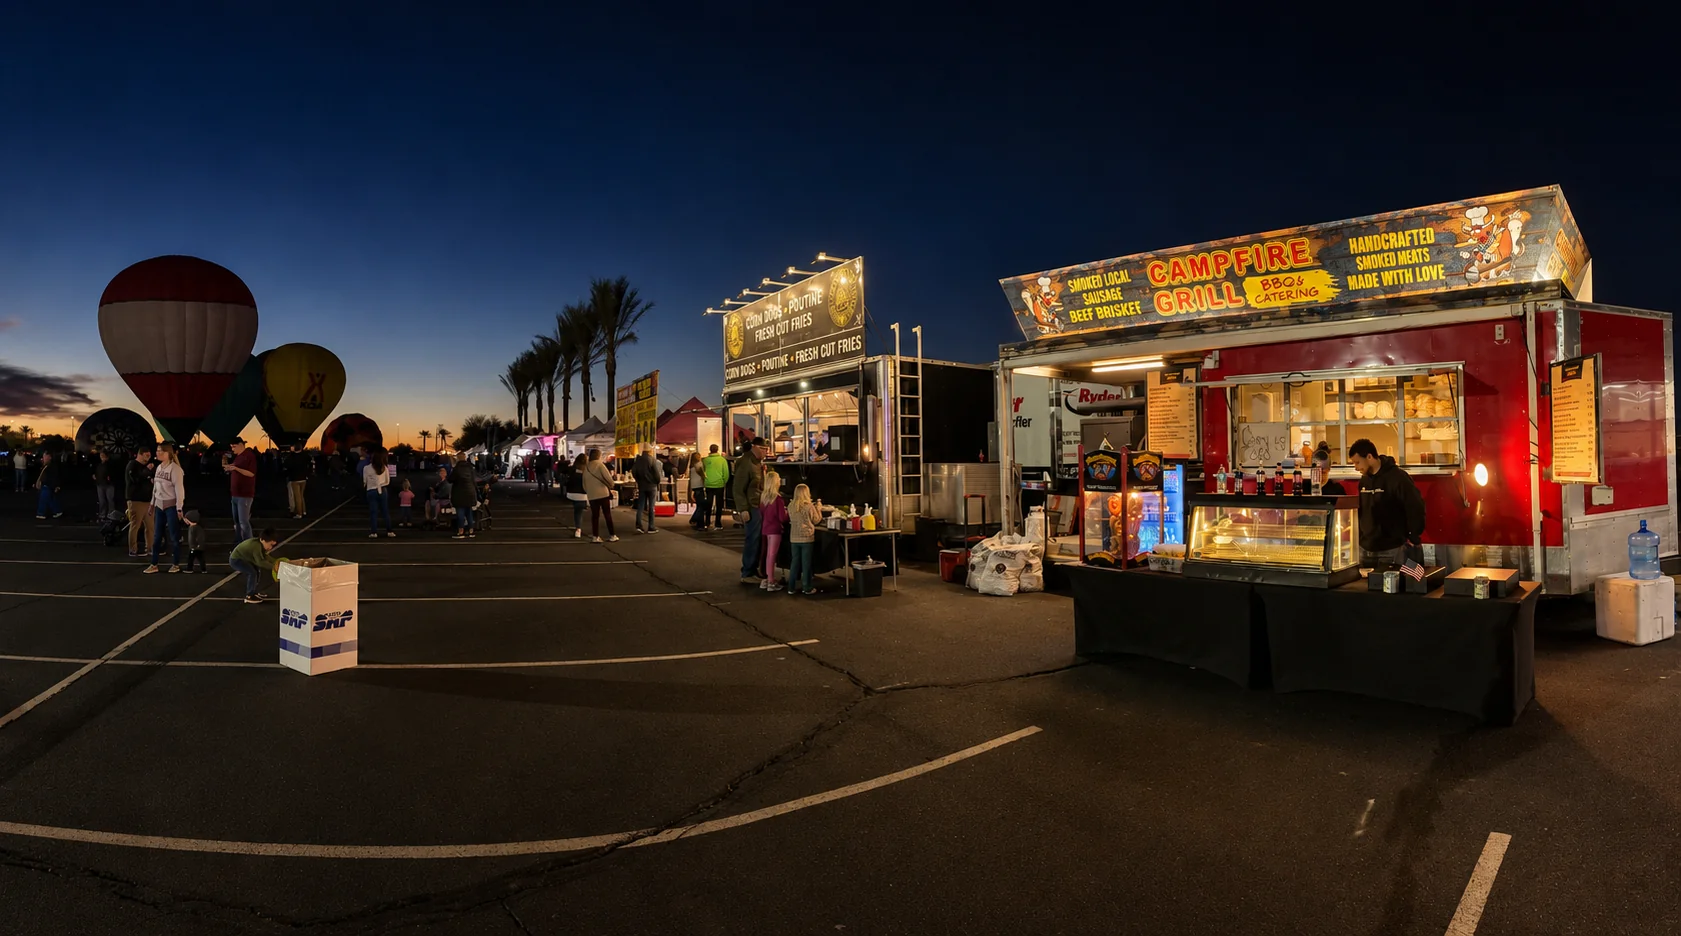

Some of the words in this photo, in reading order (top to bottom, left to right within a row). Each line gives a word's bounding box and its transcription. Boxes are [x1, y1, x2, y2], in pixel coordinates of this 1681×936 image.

[1349, 227, 1435, 254] HANDCRAFTED
[1147, 237, 1312, 286] CAMPFIRE
[1356, 251, 1396, 271] SMOKED
[1397, 247, 1430, 266] MEATS
[1068, 274, 1103, 293] SMOKED
[1103, 269, 1132, 286] LOCAL
[1347, 272, 1379, 291] MADE
[1380, 268, 1413, 286] WITH
[1415, 264, 1446, 282] LOVE
[788, 288, 823, 314] POUTINE
[1082, 286, 1123, 305] SAUSAGE
[1154, 281, 1245, 316] GRILL
[1254, 286, 1319, 304] CATERING
[755, 324, 775, 343] FRESH
[776, 320, 790, 336] CUT
[791, 312, 813, 331] FRIES
[1069, 307, 1093, 323] BEEF
[761, 353, 789, 372] POUTINE
[795, 345, 819, 364] FRESH
[820, 341, 836, 358] CUT
[838, 335, 862, 354] FRIES
[1079, 388, 1122, 404] Ryder
